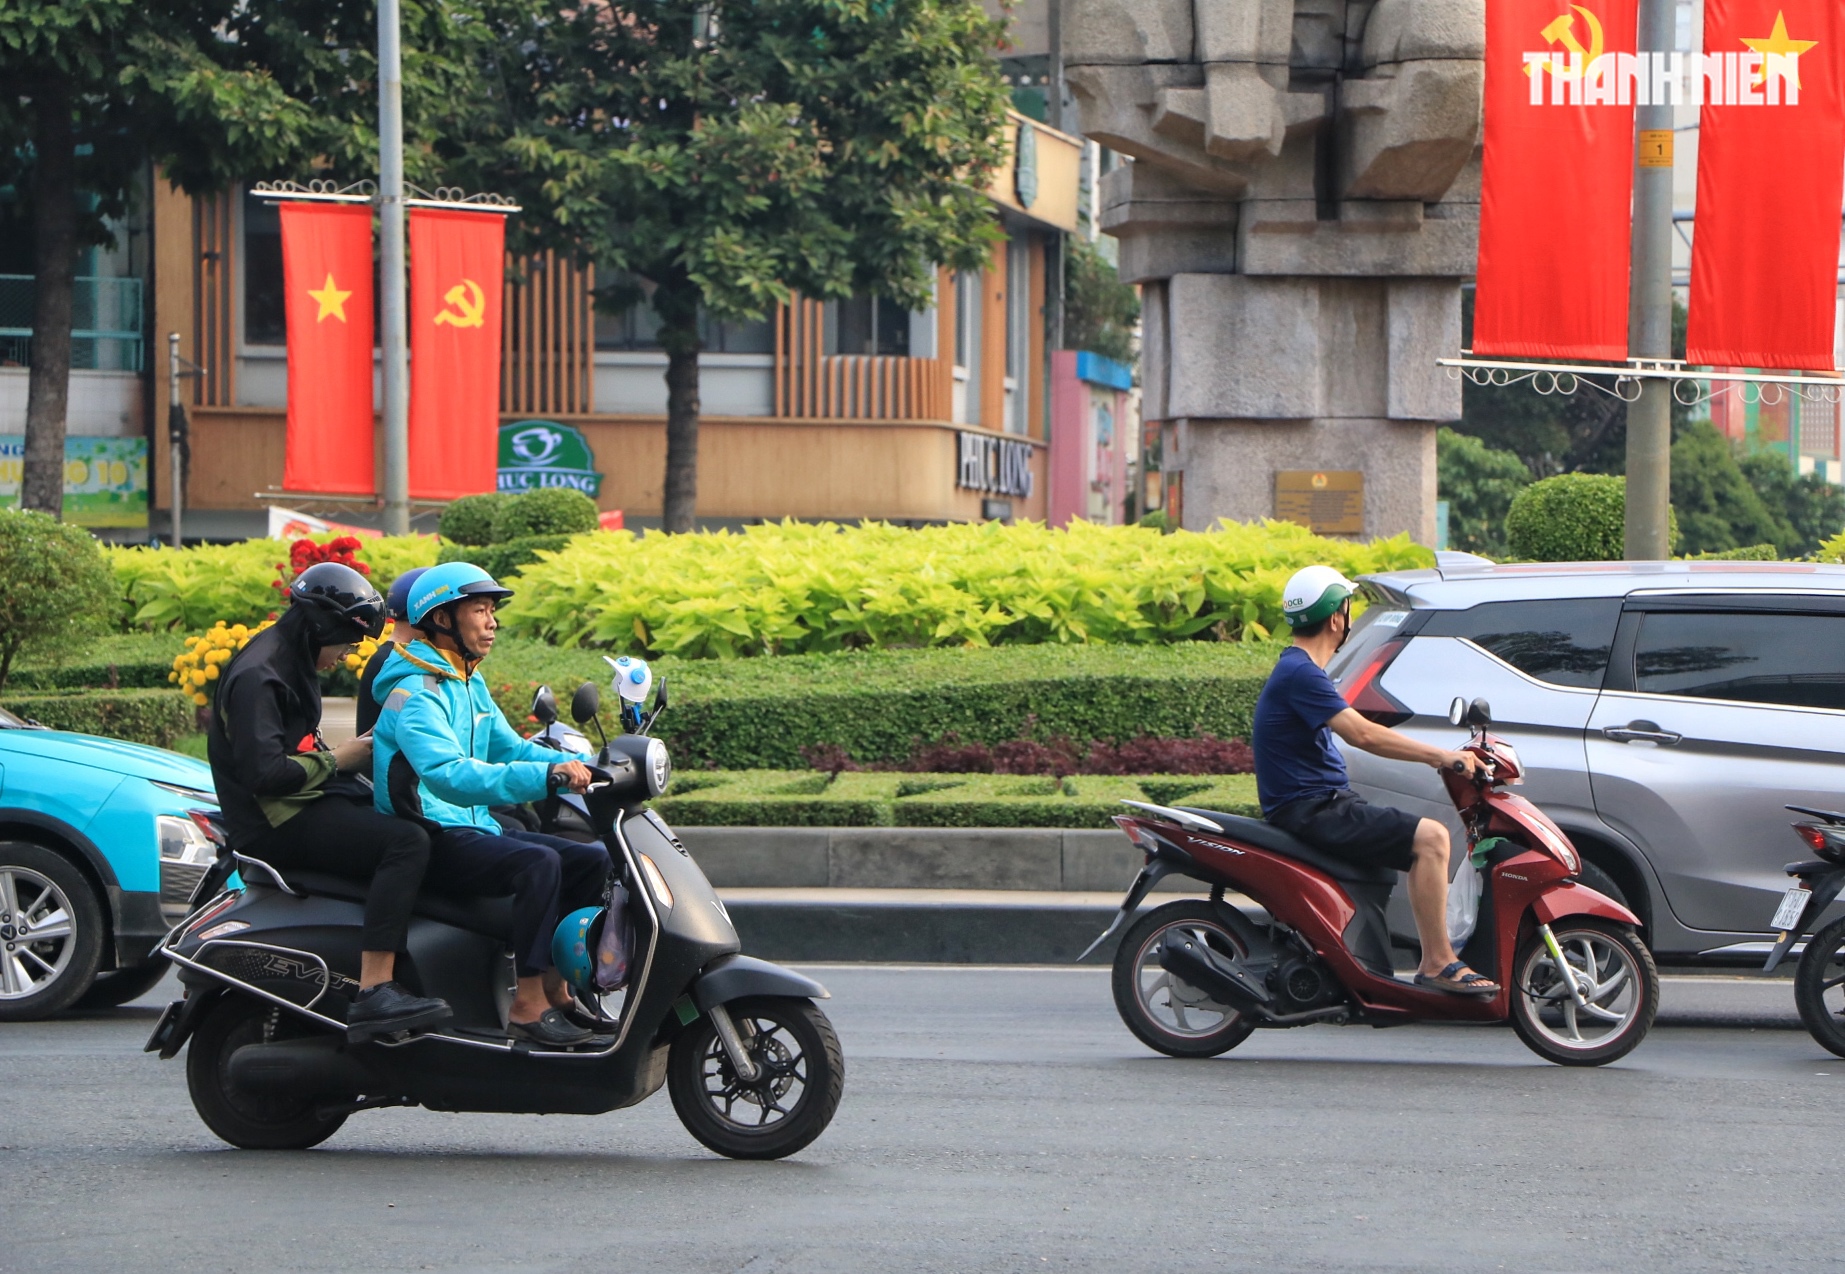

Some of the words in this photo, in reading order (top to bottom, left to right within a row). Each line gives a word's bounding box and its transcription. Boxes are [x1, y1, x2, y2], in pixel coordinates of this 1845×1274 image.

[1656, 143, 1662, 155] 1
[540, 472, 596, 493] LONG
[413, 590, 437, 611] XANH
[1287, 597, 1304, 608] OCB
[1186, 835, 1246, 856] VISION
[1501, 871, 1529, 882] HONDA
[264, 953, 346, 990] EVO
